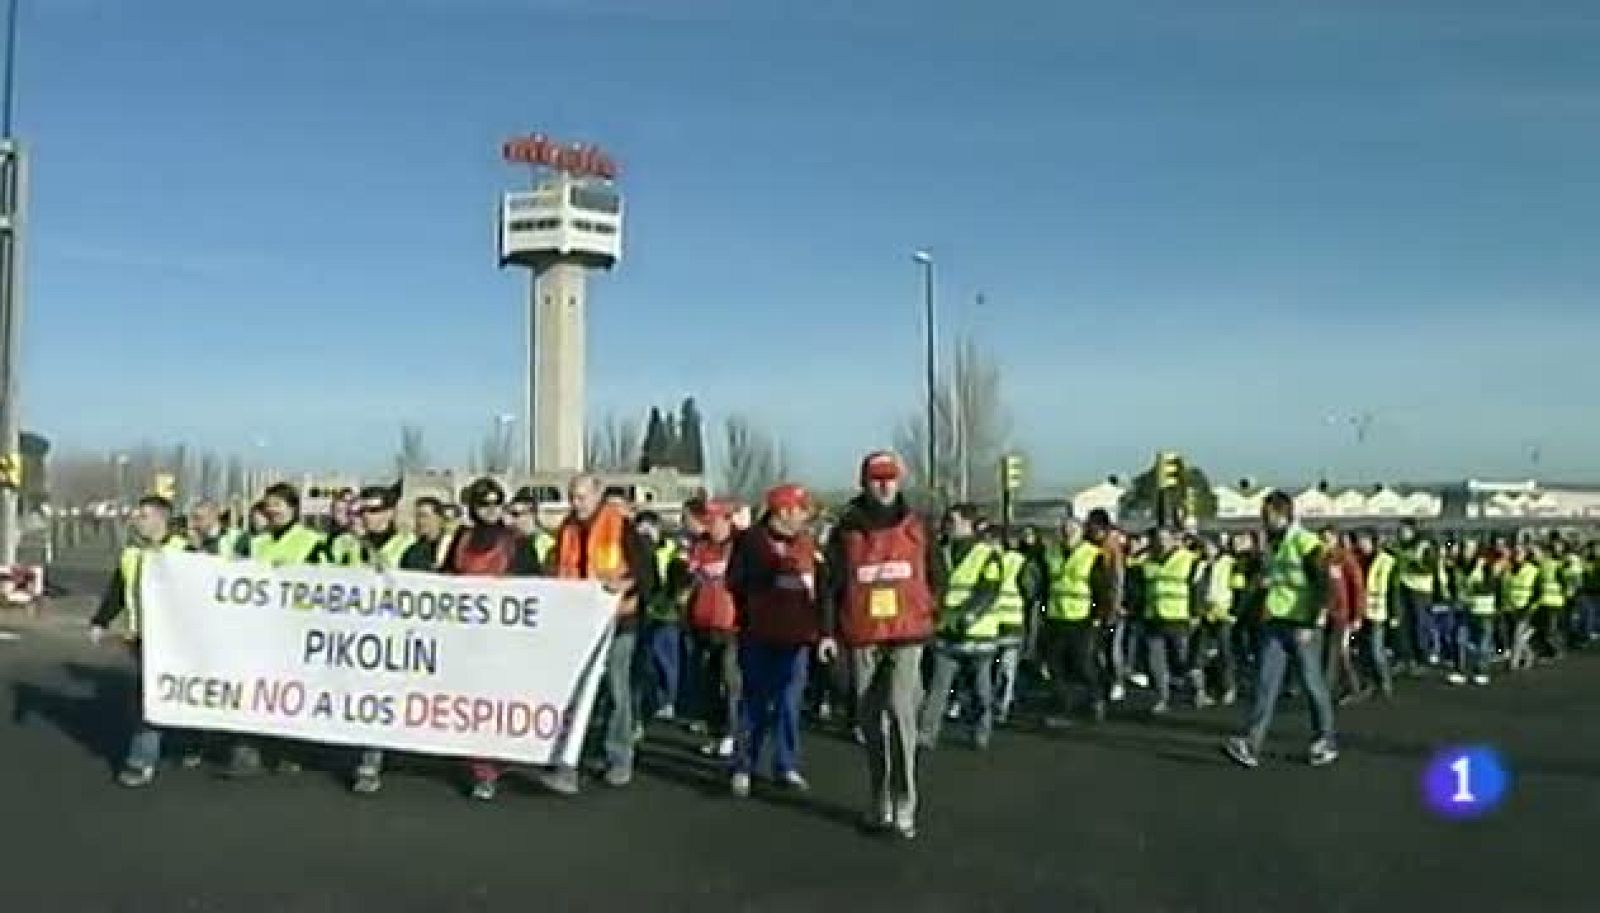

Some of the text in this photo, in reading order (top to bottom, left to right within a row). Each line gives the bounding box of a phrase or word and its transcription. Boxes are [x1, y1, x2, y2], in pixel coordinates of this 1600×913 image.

[215, 577, 539, 626] LOS TRABAJADORES DE
[304, 629, 437, 673] PIKOLÍN
[252, 678, 306, 716] NO
[313, 693, 333, 717] A
[345, 694, 395, 725] LOS
